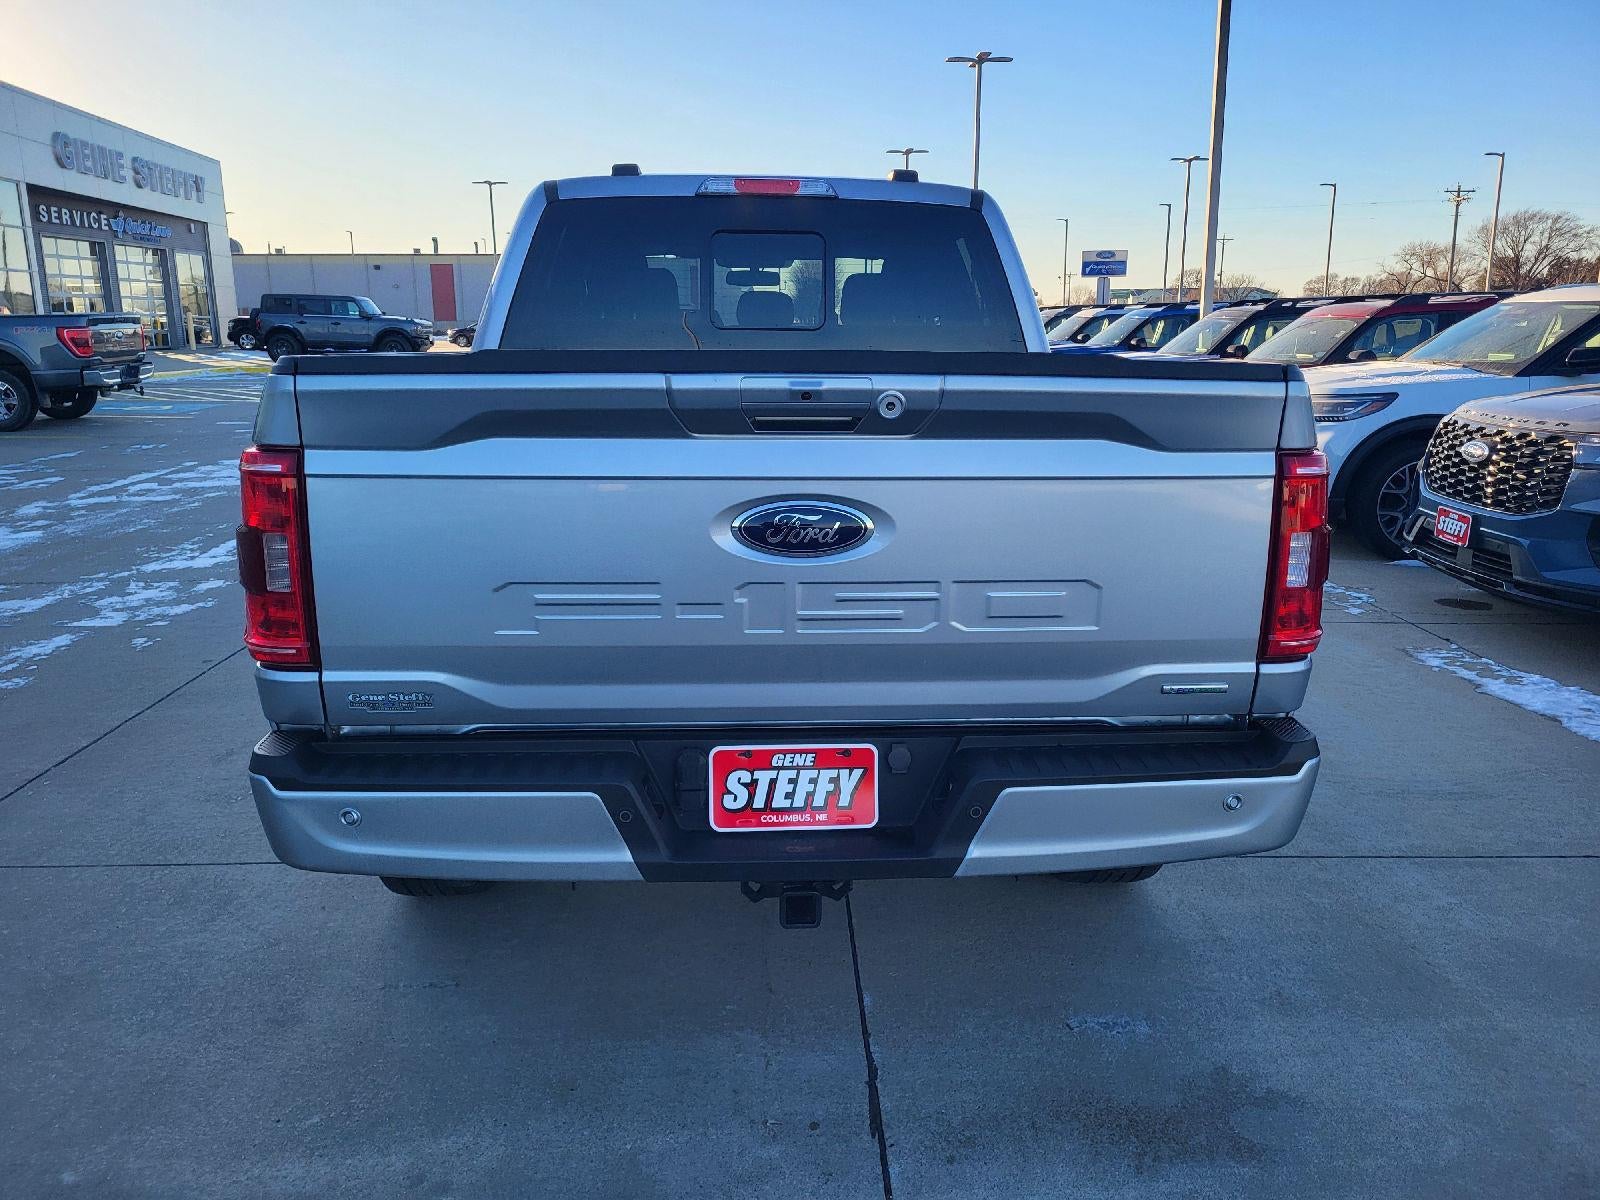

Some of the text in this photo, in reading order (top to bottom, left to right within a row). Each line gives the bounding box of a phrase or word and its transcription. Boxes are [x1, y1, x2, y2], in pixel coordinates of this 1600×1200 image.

[52, 132, 205, 203] GENE STEFFY
[38, 204, 109, 231] SERVICE
[125, 217, 151, 235] Quick
[765, 513, 841, 544] Ford
[1438, 516, 1467, 537] STEFFY
[492, 579, 1103, 635] F-150
[348, 692, 432, 702] Gene Steffy
[771, 752, 816, 767] GENE
[721, 768, 868, 812] STEFFY
[760, 813, 828, 823] COLUMBUS, NE
